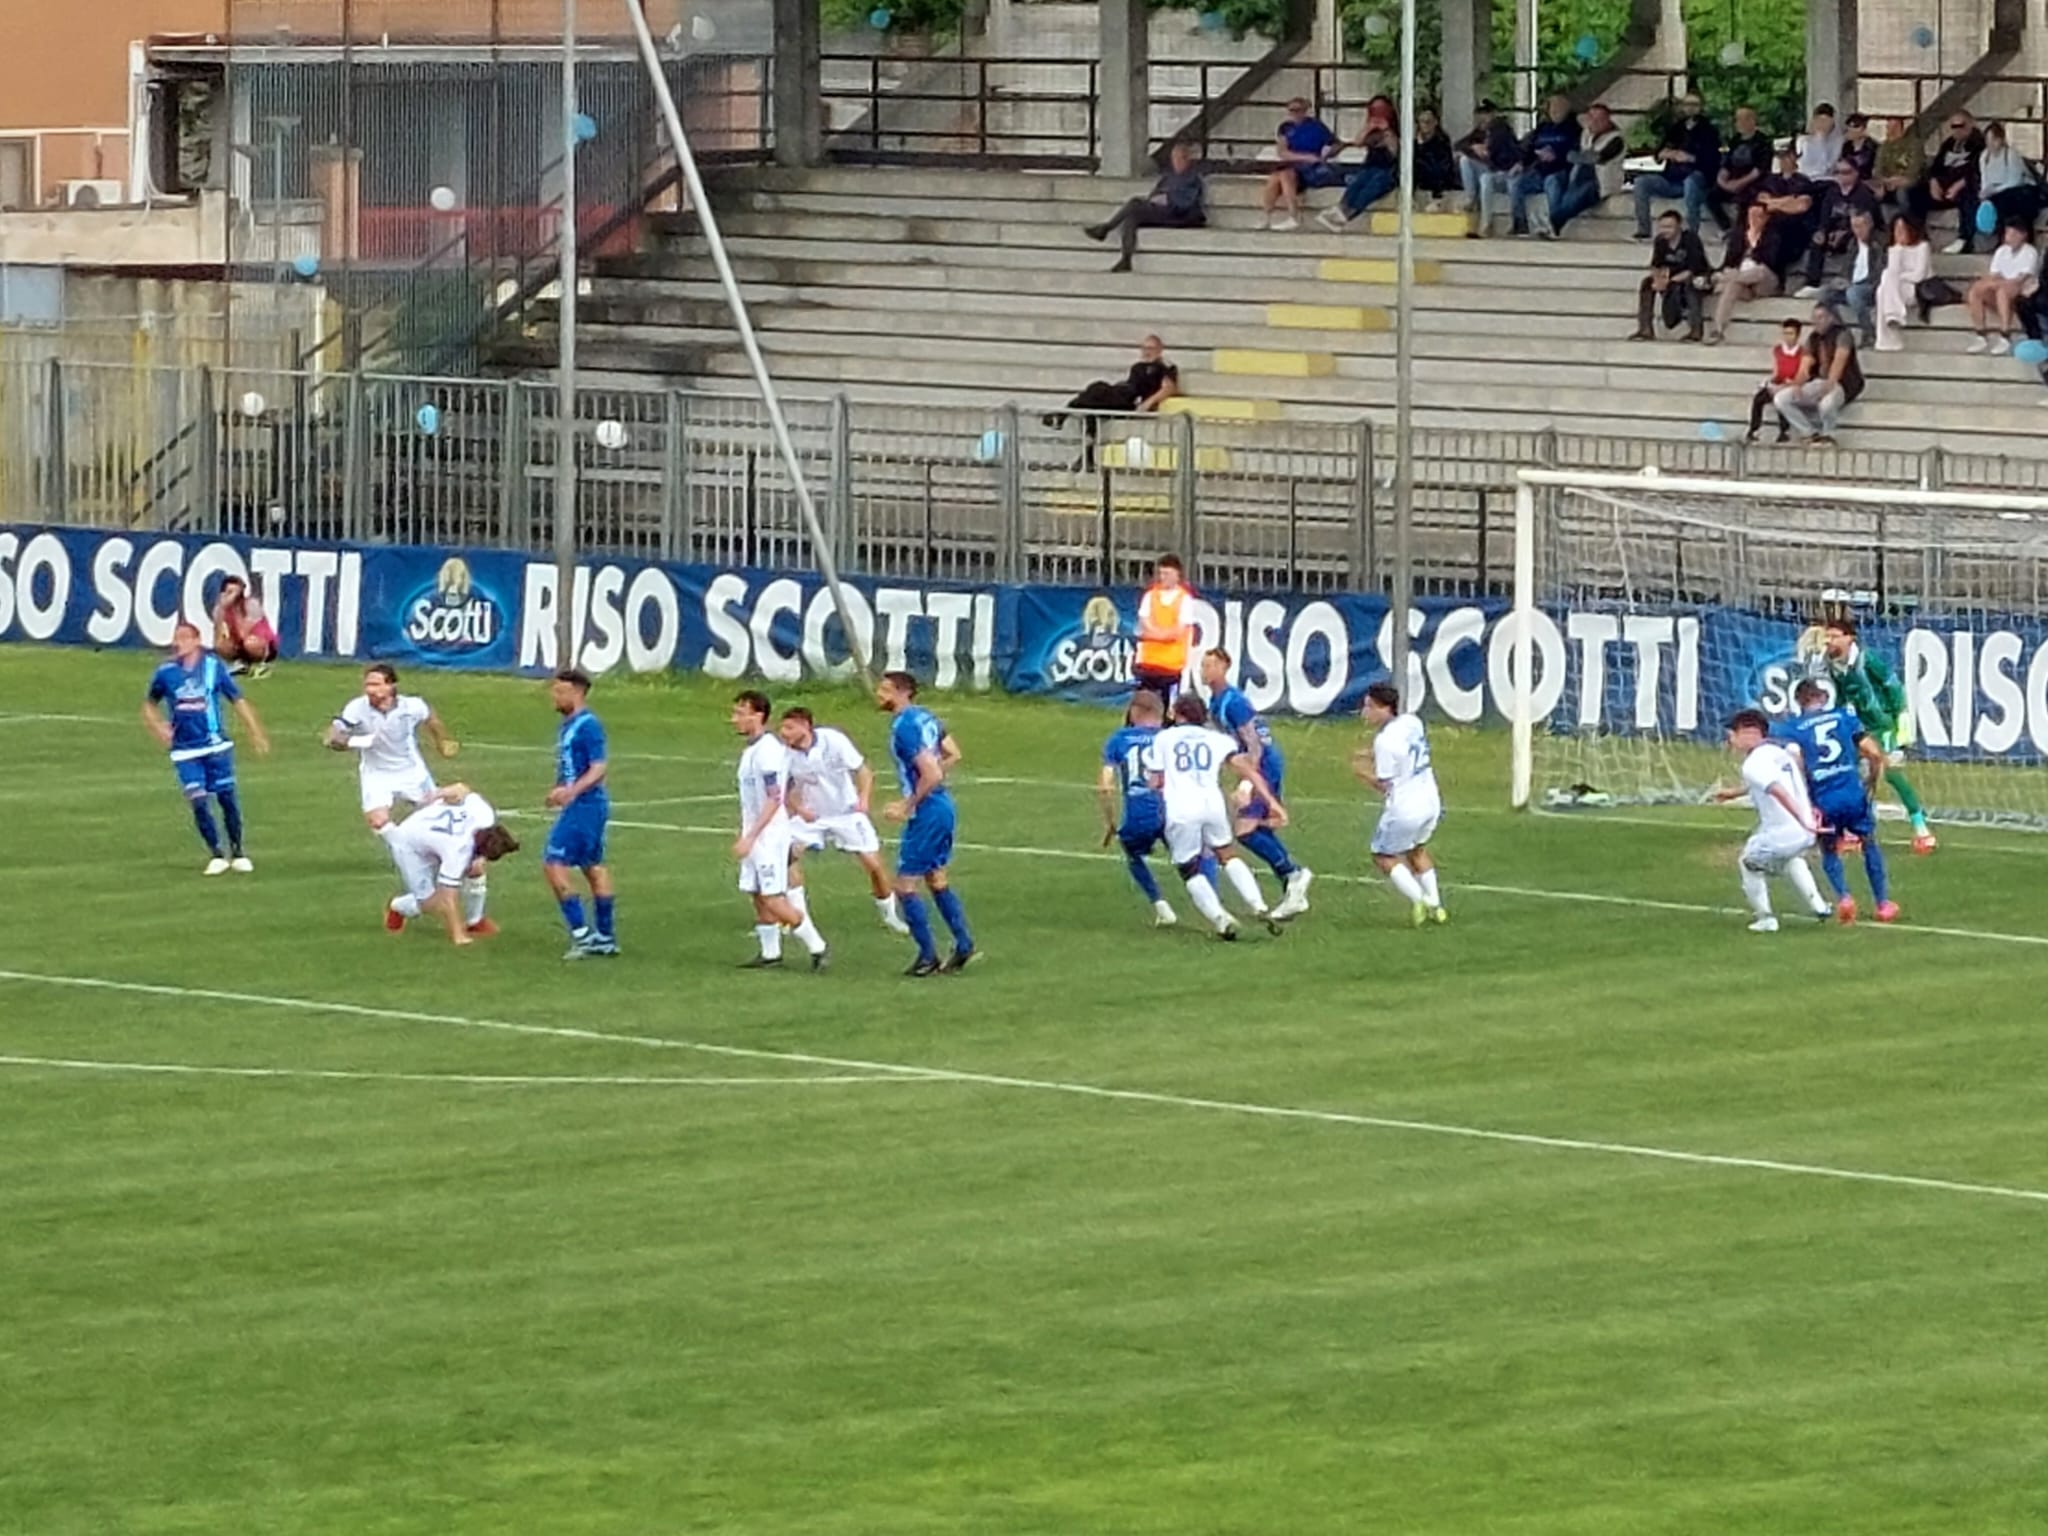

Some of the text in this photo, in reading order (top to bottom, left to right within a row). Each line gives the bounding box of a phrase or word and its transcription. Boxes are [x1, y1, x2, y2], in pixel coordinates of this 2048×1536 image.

[410, 597, 492, 644] Scotti
[520, 562, 995, 691] RISO SCOTTI
[1051, 637, 1136, 684] Scott
[1173, 740, 1213, 773] 80
[1813, 719, 1843, 764] 5
